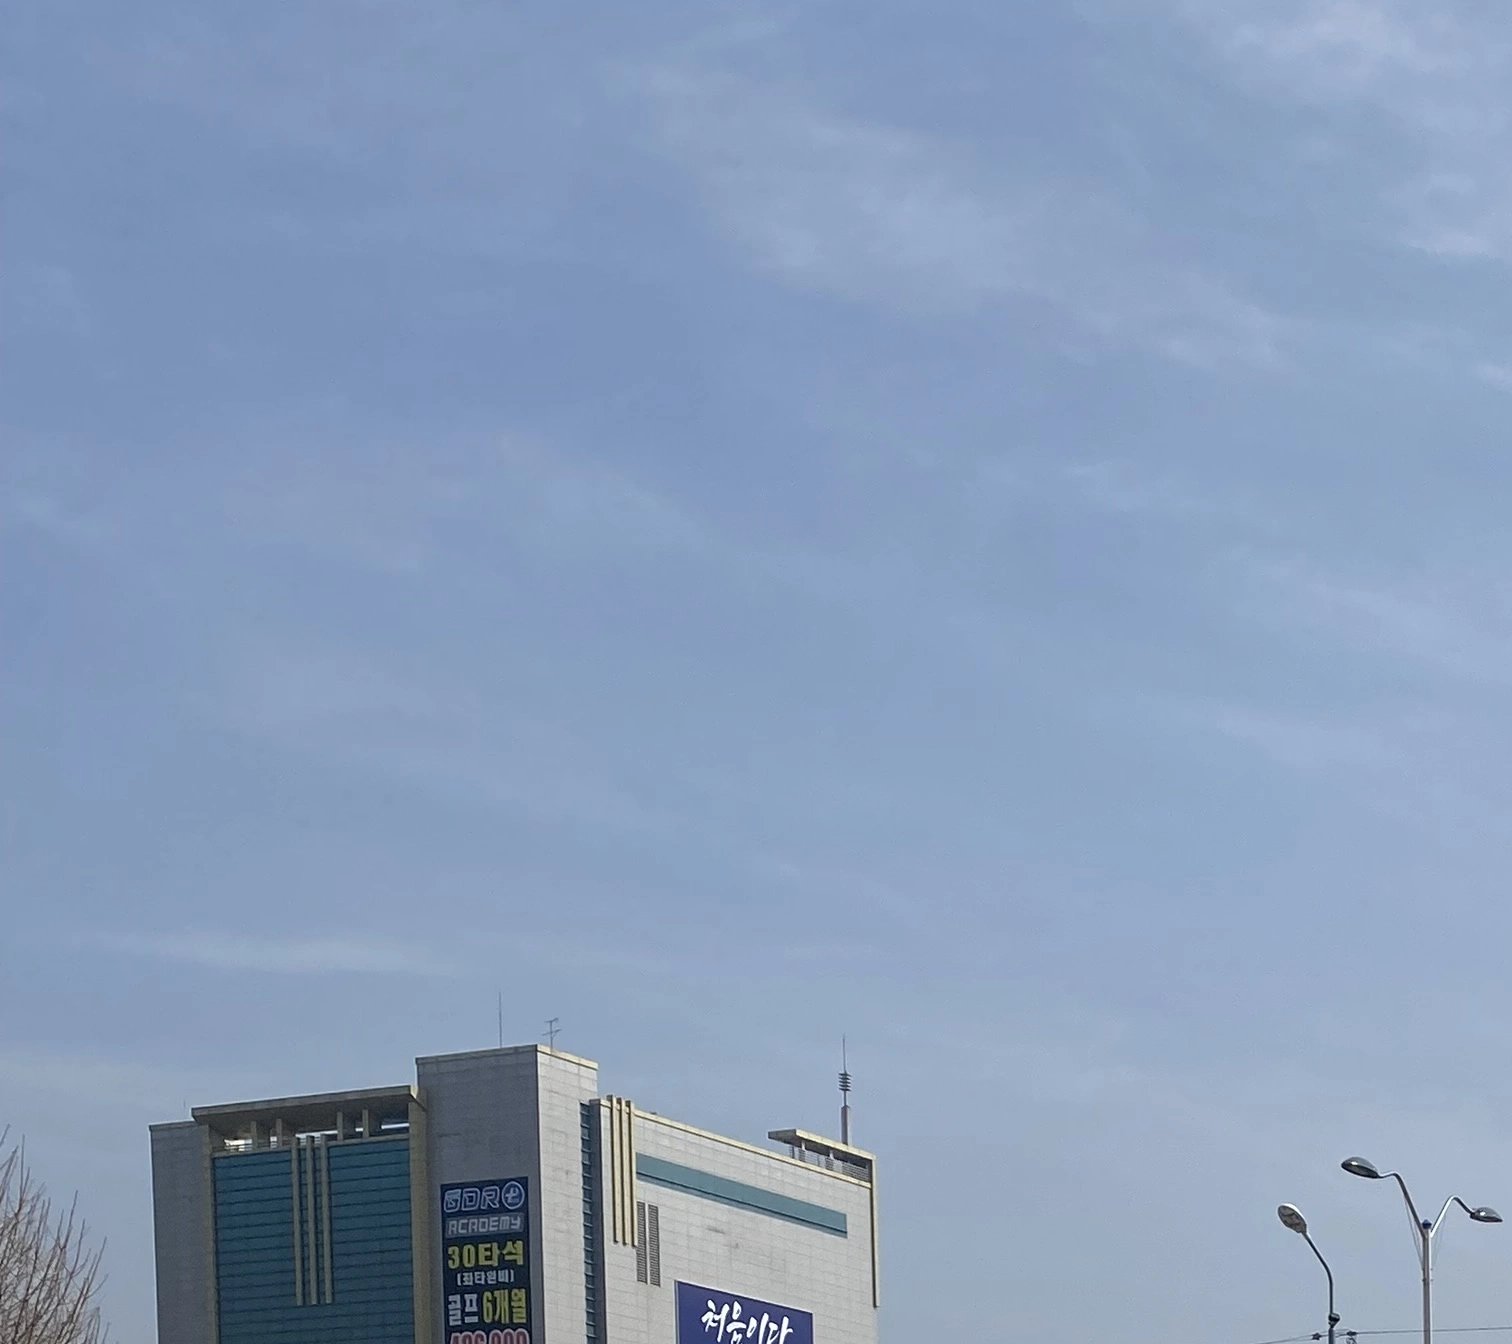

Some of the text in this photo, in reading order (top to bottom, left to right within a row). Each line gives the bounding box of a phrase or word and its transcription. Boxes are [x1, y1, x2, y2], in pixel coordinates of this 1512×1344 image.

[447, 1215, 521, 1236] ACADEMY
[447, 1240, 524, 1269] 30타석
[448, 1288, 527, 1327] 골프 6개월
